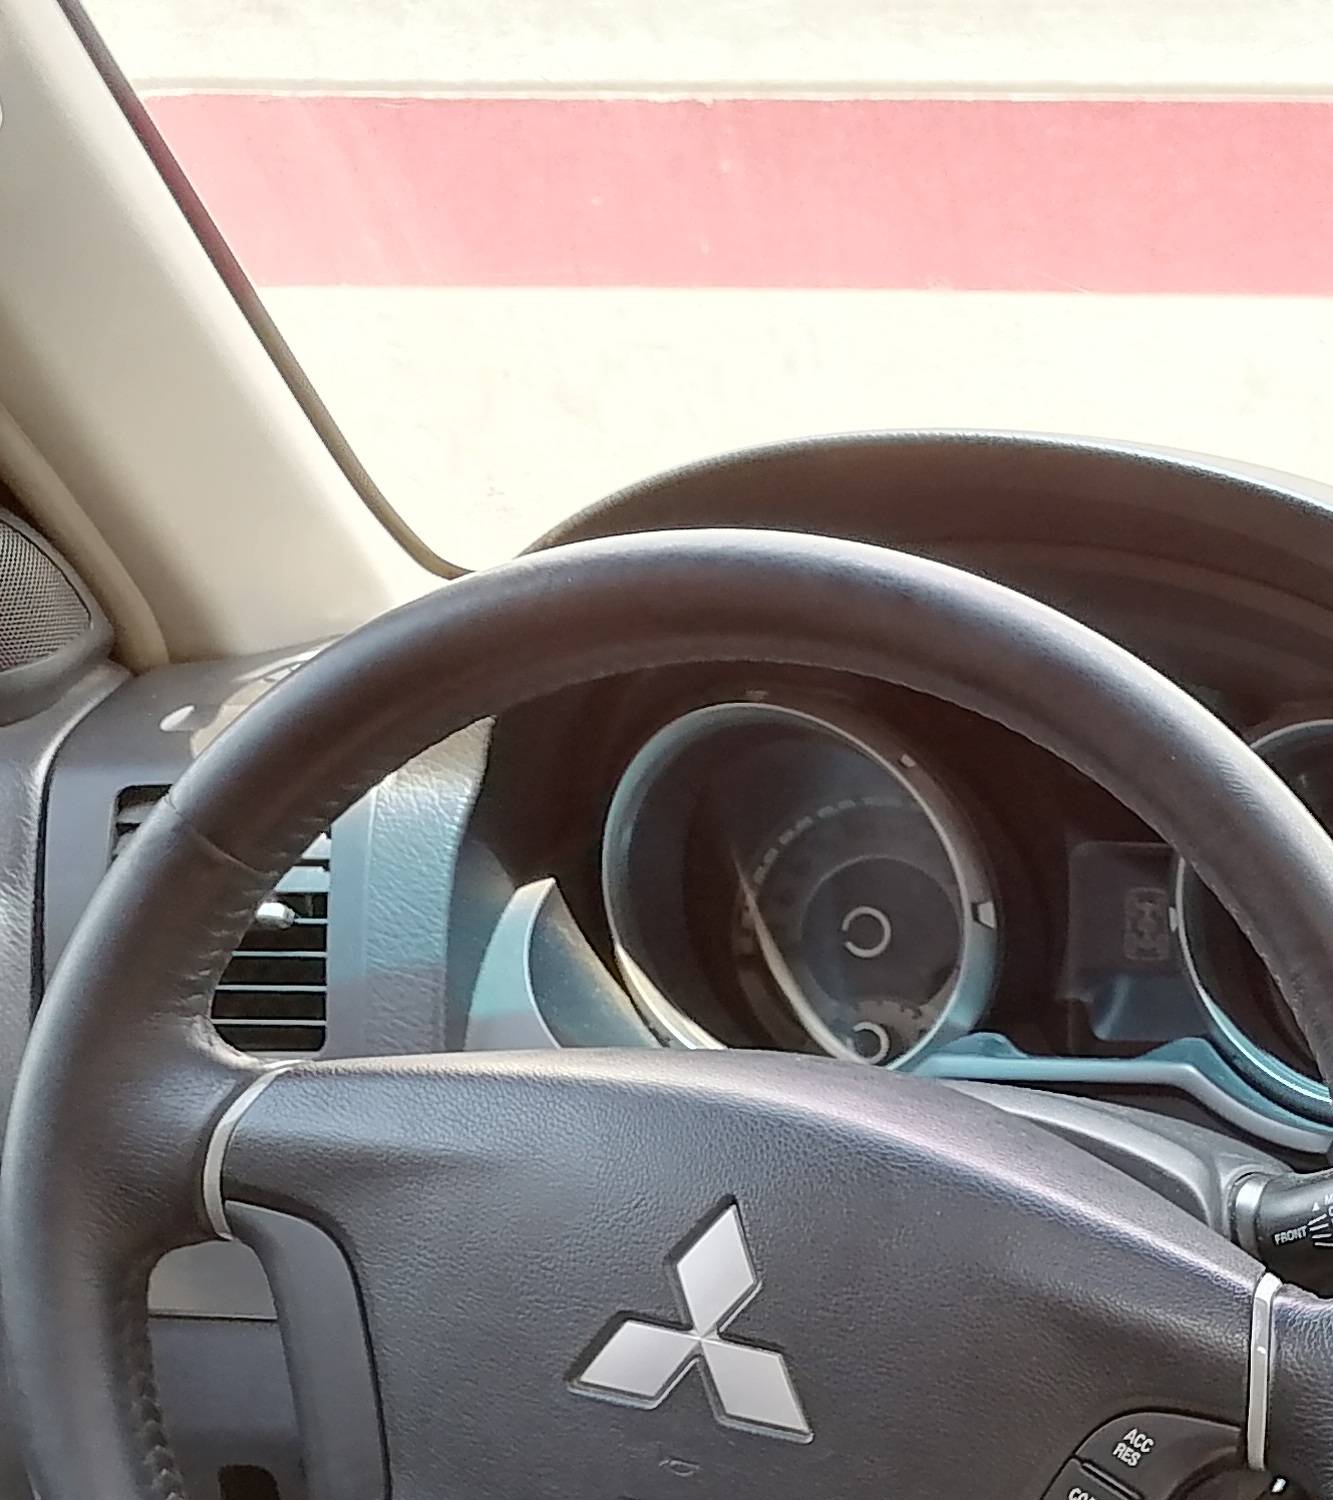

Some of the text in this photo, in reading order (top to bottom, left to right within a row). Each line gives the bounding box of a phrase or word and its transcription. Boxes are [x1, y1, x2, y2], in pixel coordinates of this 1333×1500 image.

[1274, 1225, 1308, 1245] FRONT
[1123, 1428, 1154, 1454] ACC
[1112, 1442, 1141, 1468] RES
